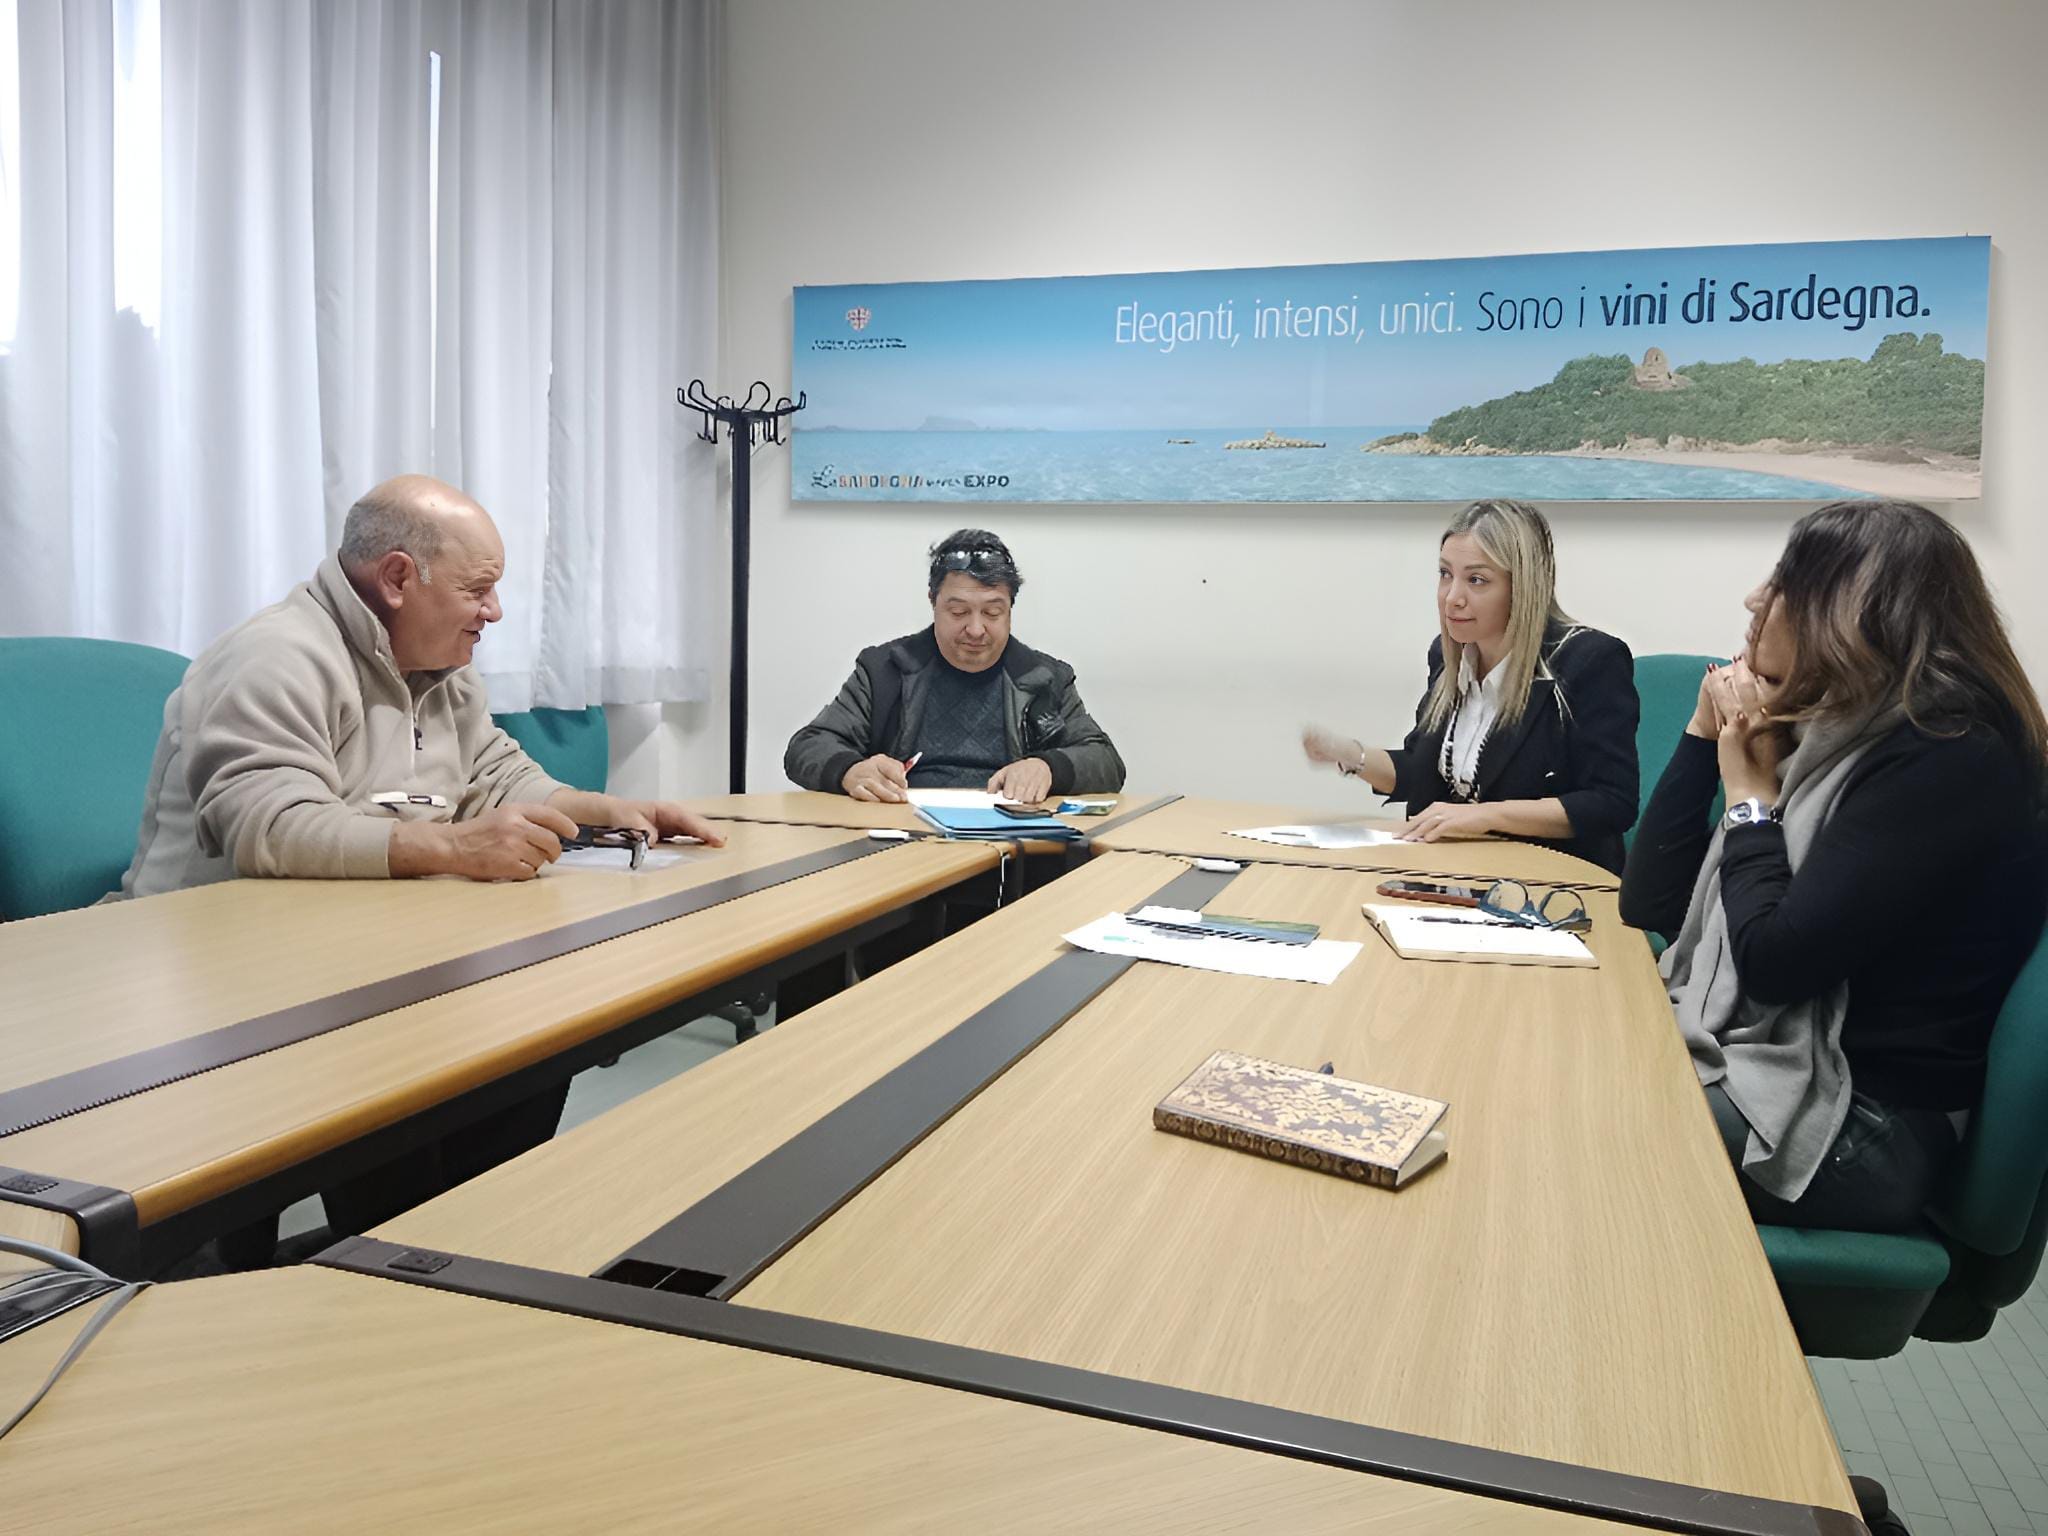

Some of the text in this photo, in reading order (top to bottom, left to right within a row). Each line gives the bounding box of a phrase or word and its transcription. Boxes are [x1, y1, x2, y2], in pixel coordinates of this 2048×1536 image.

[1115, 273, 1932, 353] Eleganti, intensi, unici. Sono i vini di Sardegna.
[963, 474, 1010, 488] EXPO
